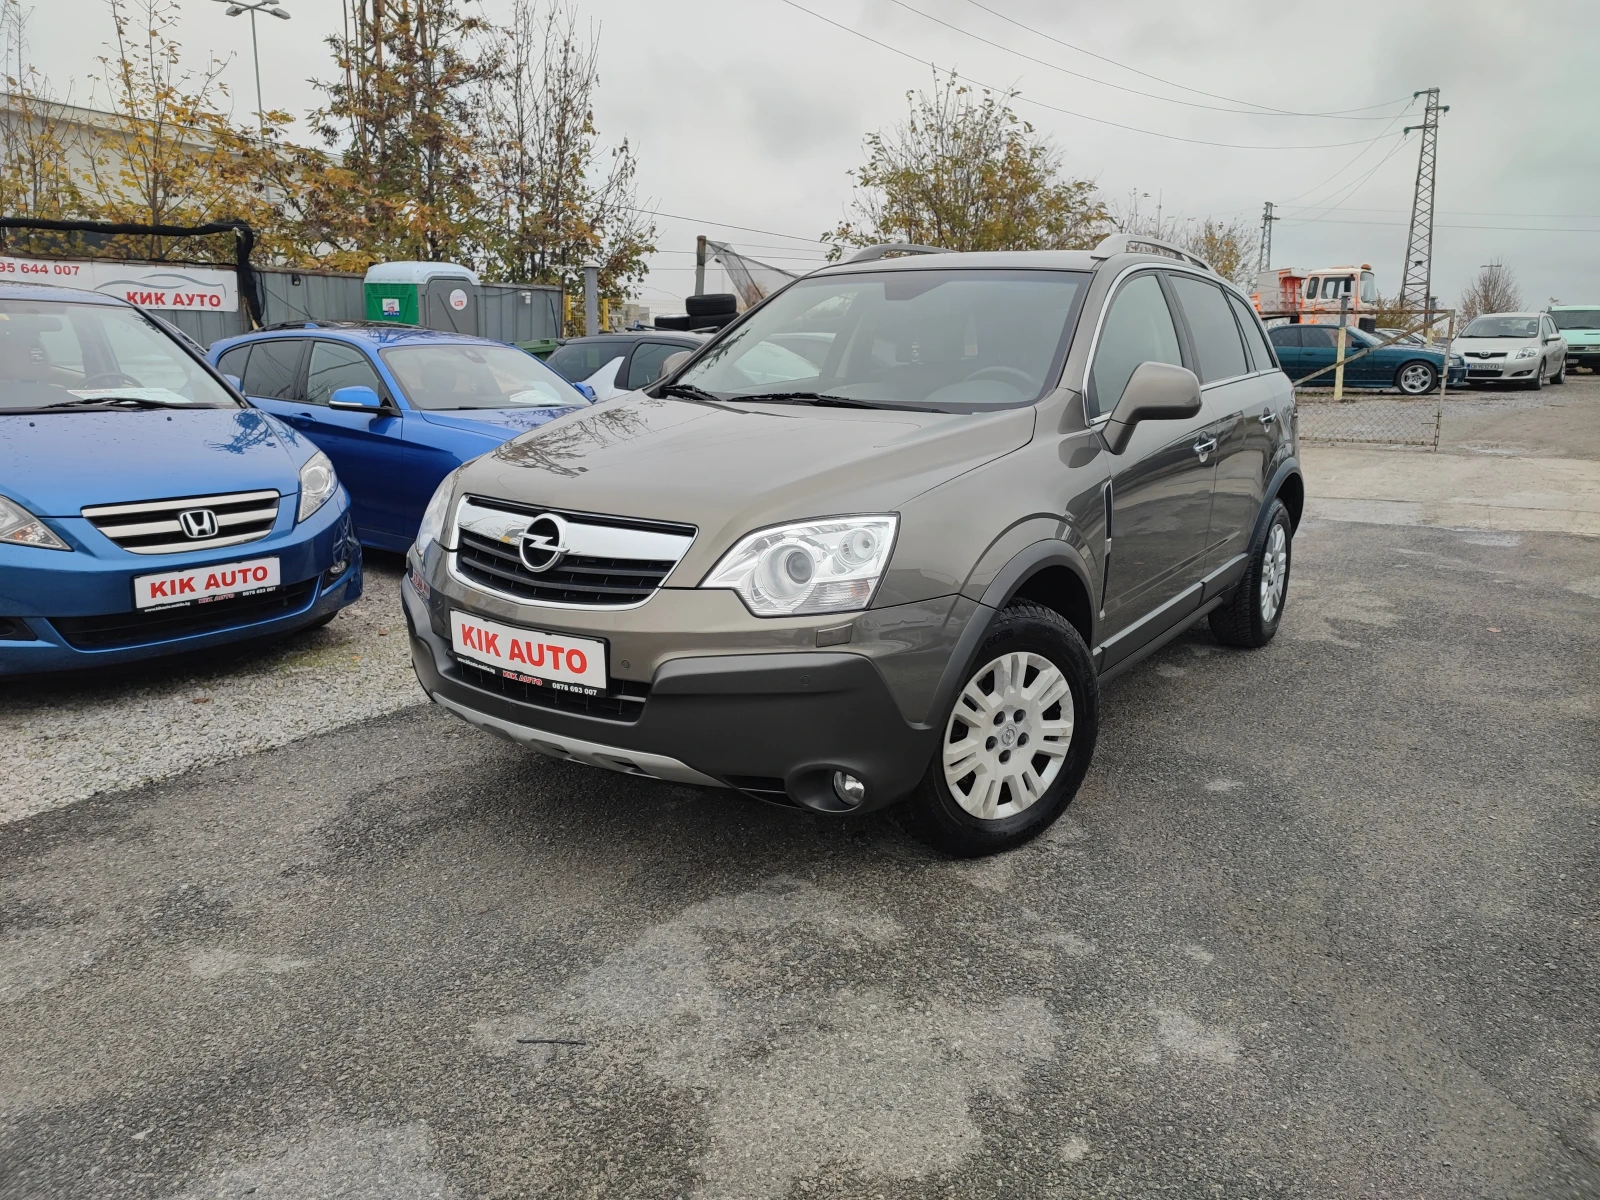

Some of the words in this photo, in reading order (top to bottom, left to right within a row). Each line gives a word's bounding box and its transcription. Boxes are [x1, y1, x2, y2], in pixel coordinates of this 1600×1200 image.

[20, 263, 49, 274] 644
[54, 265, 80, 276] 007
[126, 291, 166, 306] КИК
[172, 292, 221, 308] АУТО
[150, 576, 196, 599] KIK
[204, 565, 268, 590] AUTO
[461, 623, 501, 658] KIK
[509, 638, 588, 674] AUTO
[502, 670, 518, 680] KIK
[519, 674, 543, 686] AUTO
[552, 682, 569, 691] 0878
[570, 685, 583, 694] 693
[584, 688, 597, 696] 007
